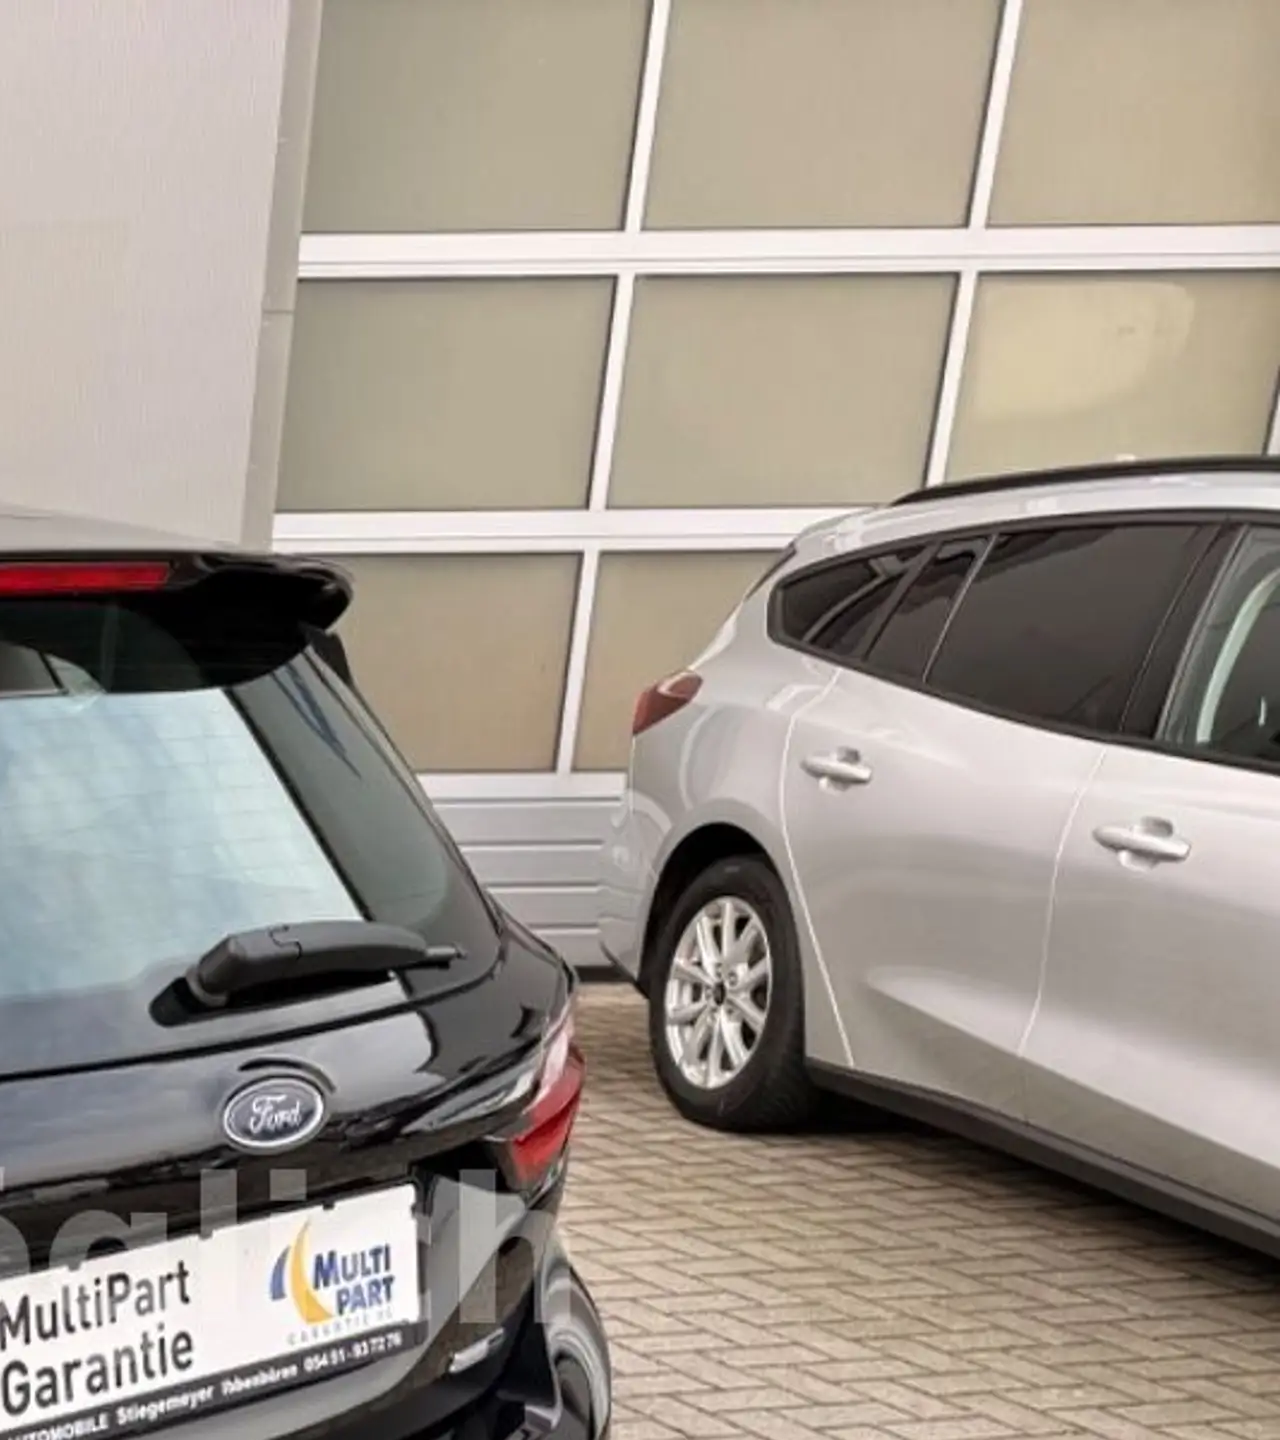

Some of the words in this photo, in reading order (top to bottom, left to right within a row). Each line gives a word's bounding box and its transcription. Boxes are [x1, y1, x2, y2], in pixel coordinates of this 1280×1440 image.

[250, 1093, 302, 1134] Ford
[313, 1242, 392, 1291] MULTI
[336, 1274, 396, 1316] PART
[2, 1322, 194, 1416] Garantie
[116, 1385, 214, 1426] Stiegemeyer
